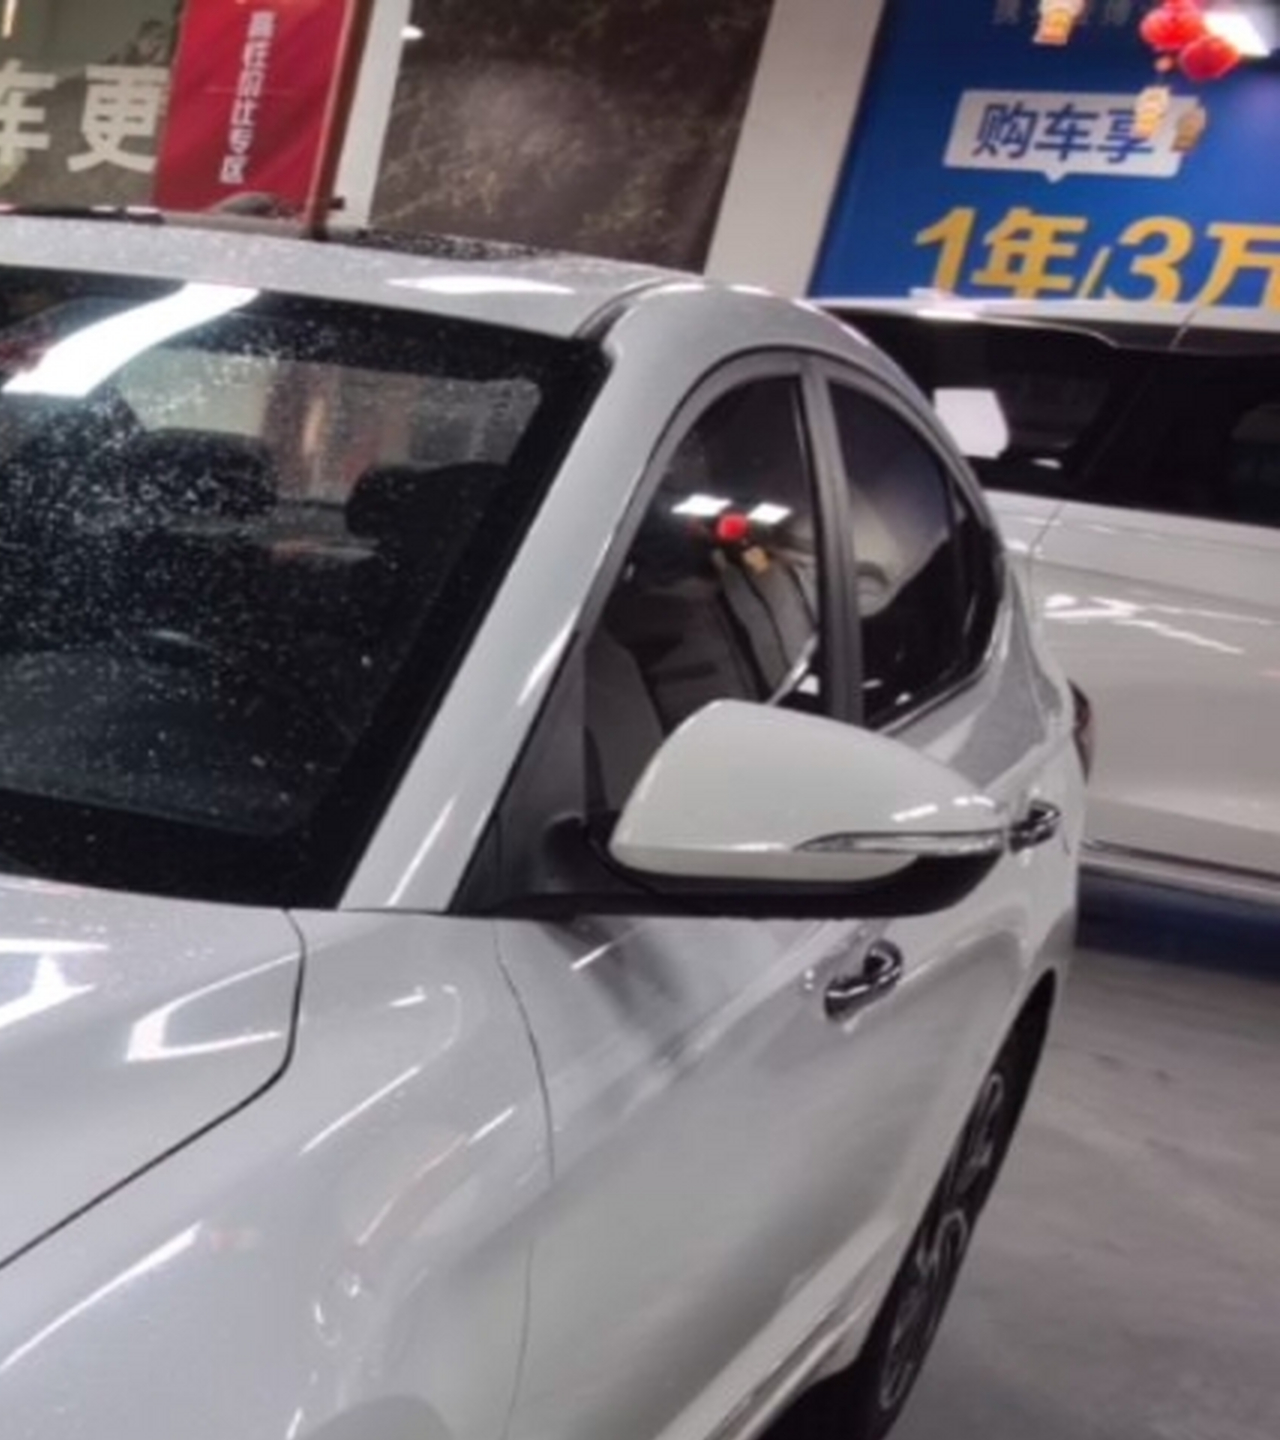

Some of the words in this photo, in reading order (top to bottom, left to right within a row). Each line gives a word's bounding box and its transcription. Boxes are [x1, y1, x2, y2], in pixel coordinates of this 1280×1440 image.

[67, 63, 170, 173] 更
[972, 102, 1154, 164] 购车享
